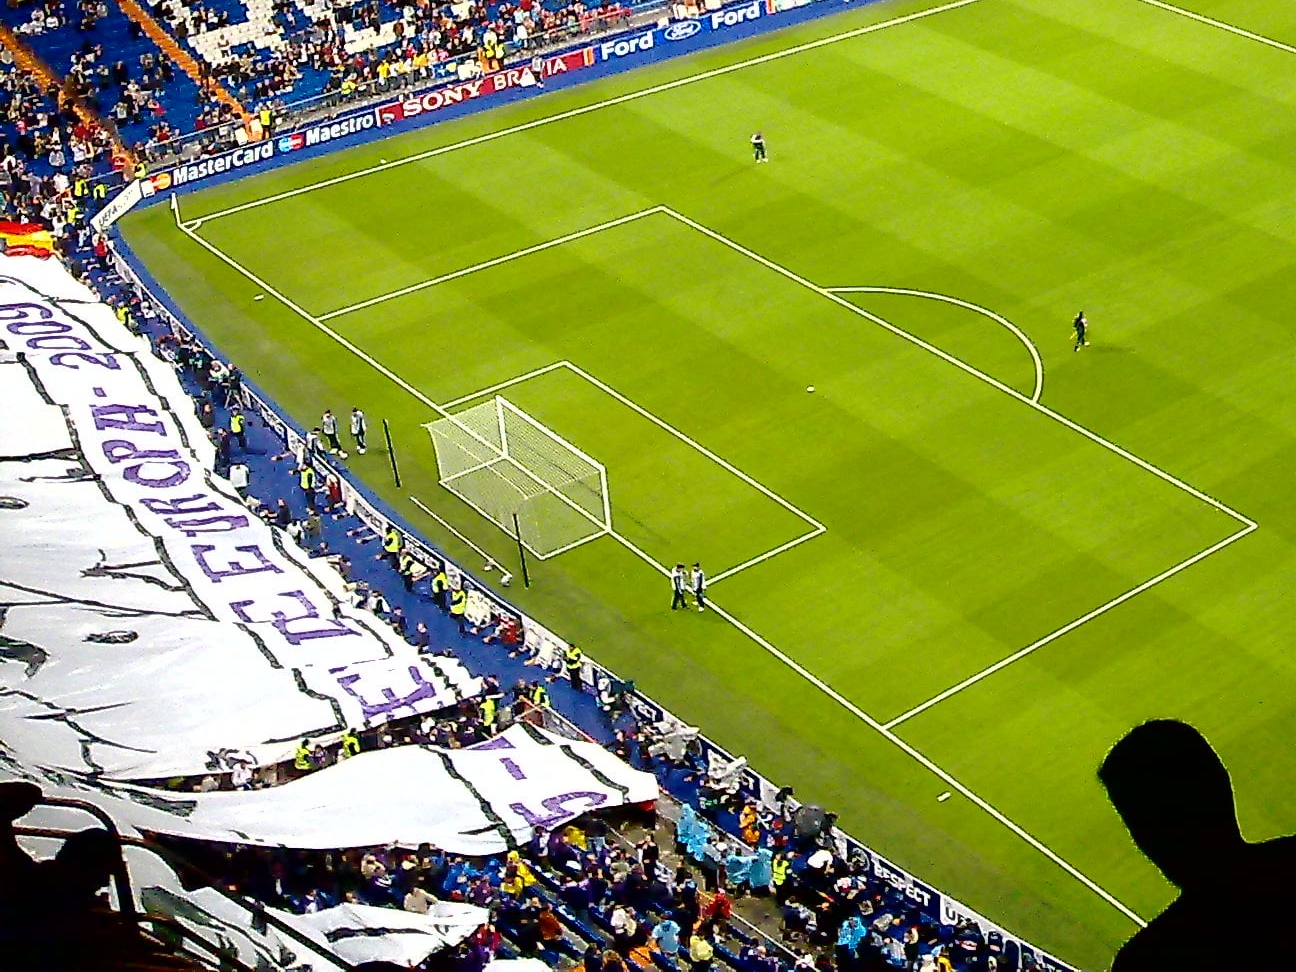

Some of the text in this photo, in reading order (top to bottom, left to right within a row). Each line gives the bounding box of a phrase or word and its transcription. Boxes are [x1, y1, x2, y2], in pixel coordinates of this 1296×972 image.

[711, 0, 761, 29] Ford
[601, 31, 654, 61] Ford
[402, 79, 485, 118] SONY
[305, 114, 374, 146] Maestro
[173, 140, 275, 186] MasterCard
[873, 861, 932, 907] RESPECT
